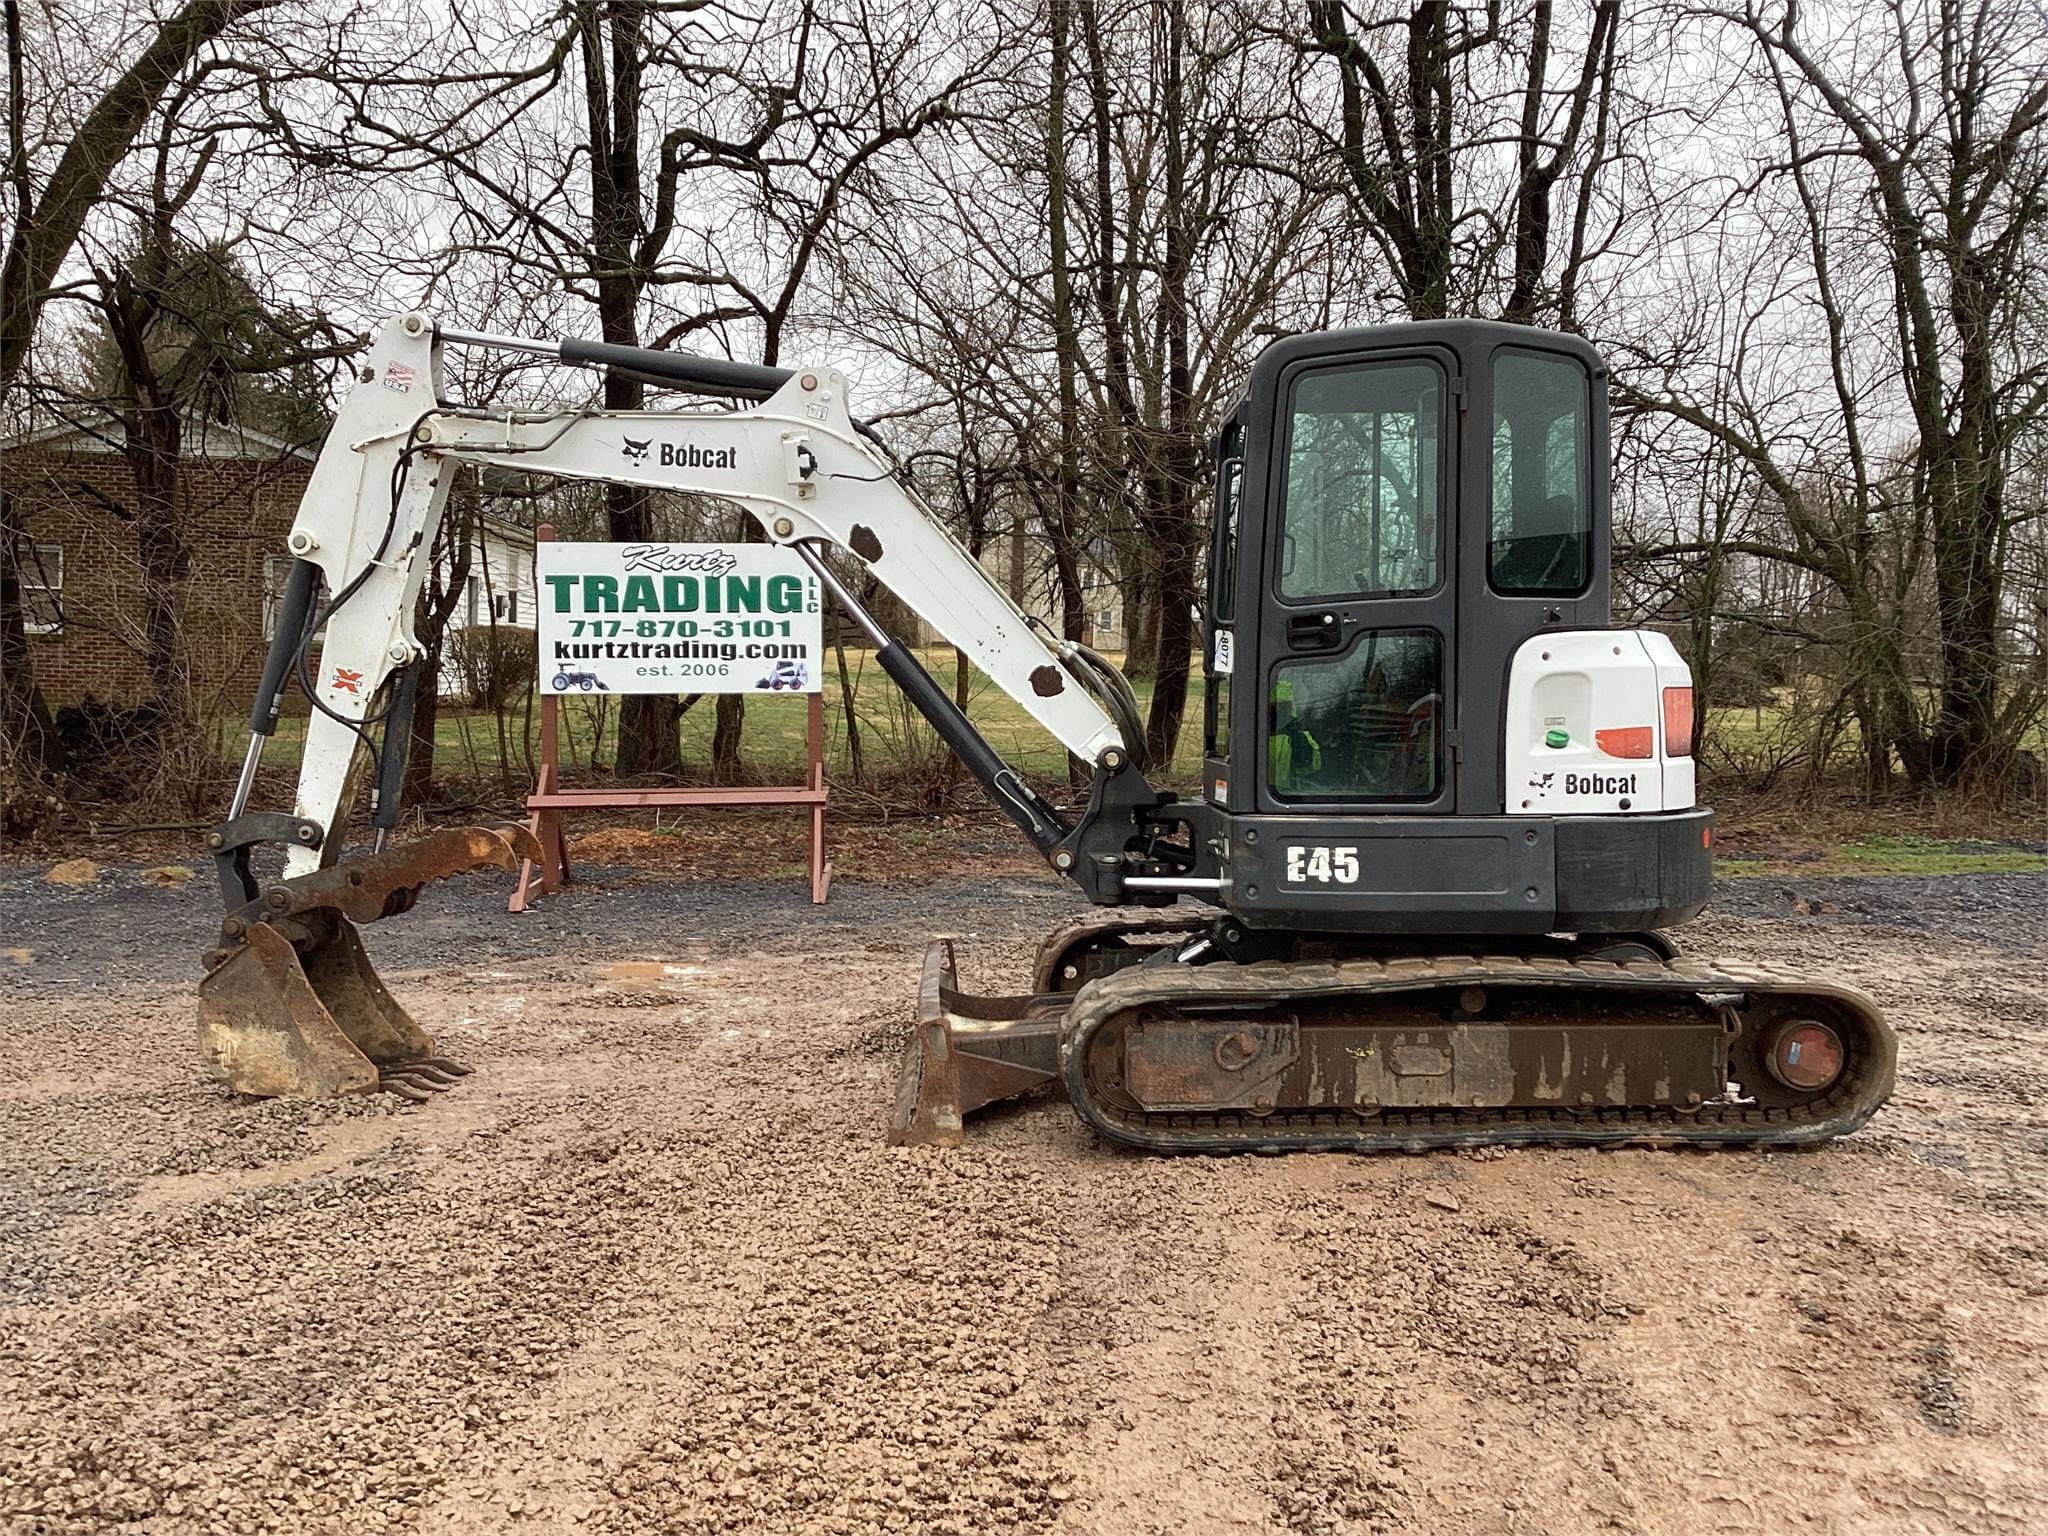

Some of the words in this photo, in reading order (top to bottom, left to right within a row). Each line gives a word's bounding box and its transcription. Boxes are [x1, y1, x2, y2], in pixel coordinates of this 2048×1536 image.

[660, 443, 736, 469] Bobcat
[622, 545, 736, 577] Kurtz
[545, 575, 802, 613] TRADING
[806, 576, 818, 613] LLC
[568, 619, 791, 637] 717-870-3101
[554, 641, 807, 661] kurtztrading.com
[1221, 637, 1229, 667] 8077
[636, 665, 673, 676] est.
[681, 664, 729, 676] 2006
[1565, 773, 1637, 794] Bobcat
[1287, 846, 1360, 883] E45
